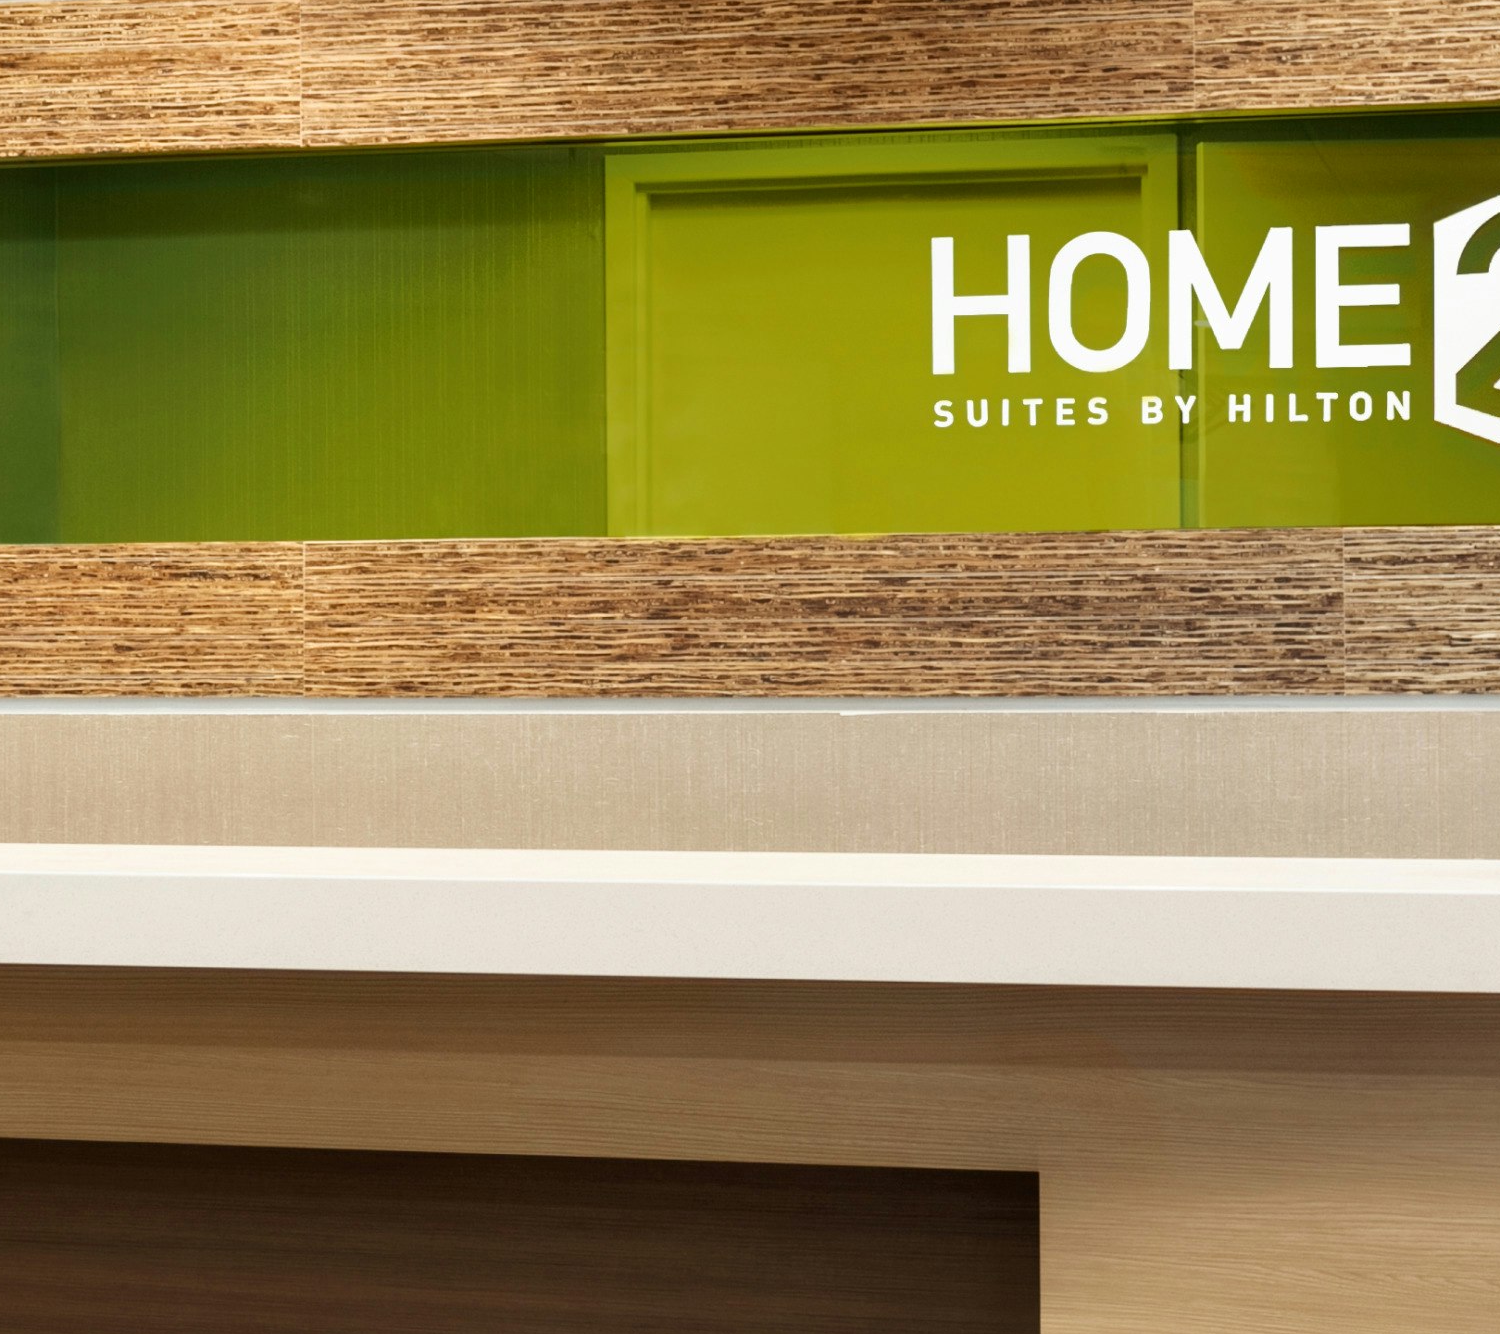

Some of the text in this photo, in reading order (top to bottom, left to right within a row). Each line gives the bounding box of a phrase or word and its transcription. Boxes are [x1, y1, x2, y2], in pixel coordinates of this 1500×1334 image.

[931, 222, 1413, 375] HOME
[932, 390, 1413, 428] SUITES BY HILTON
